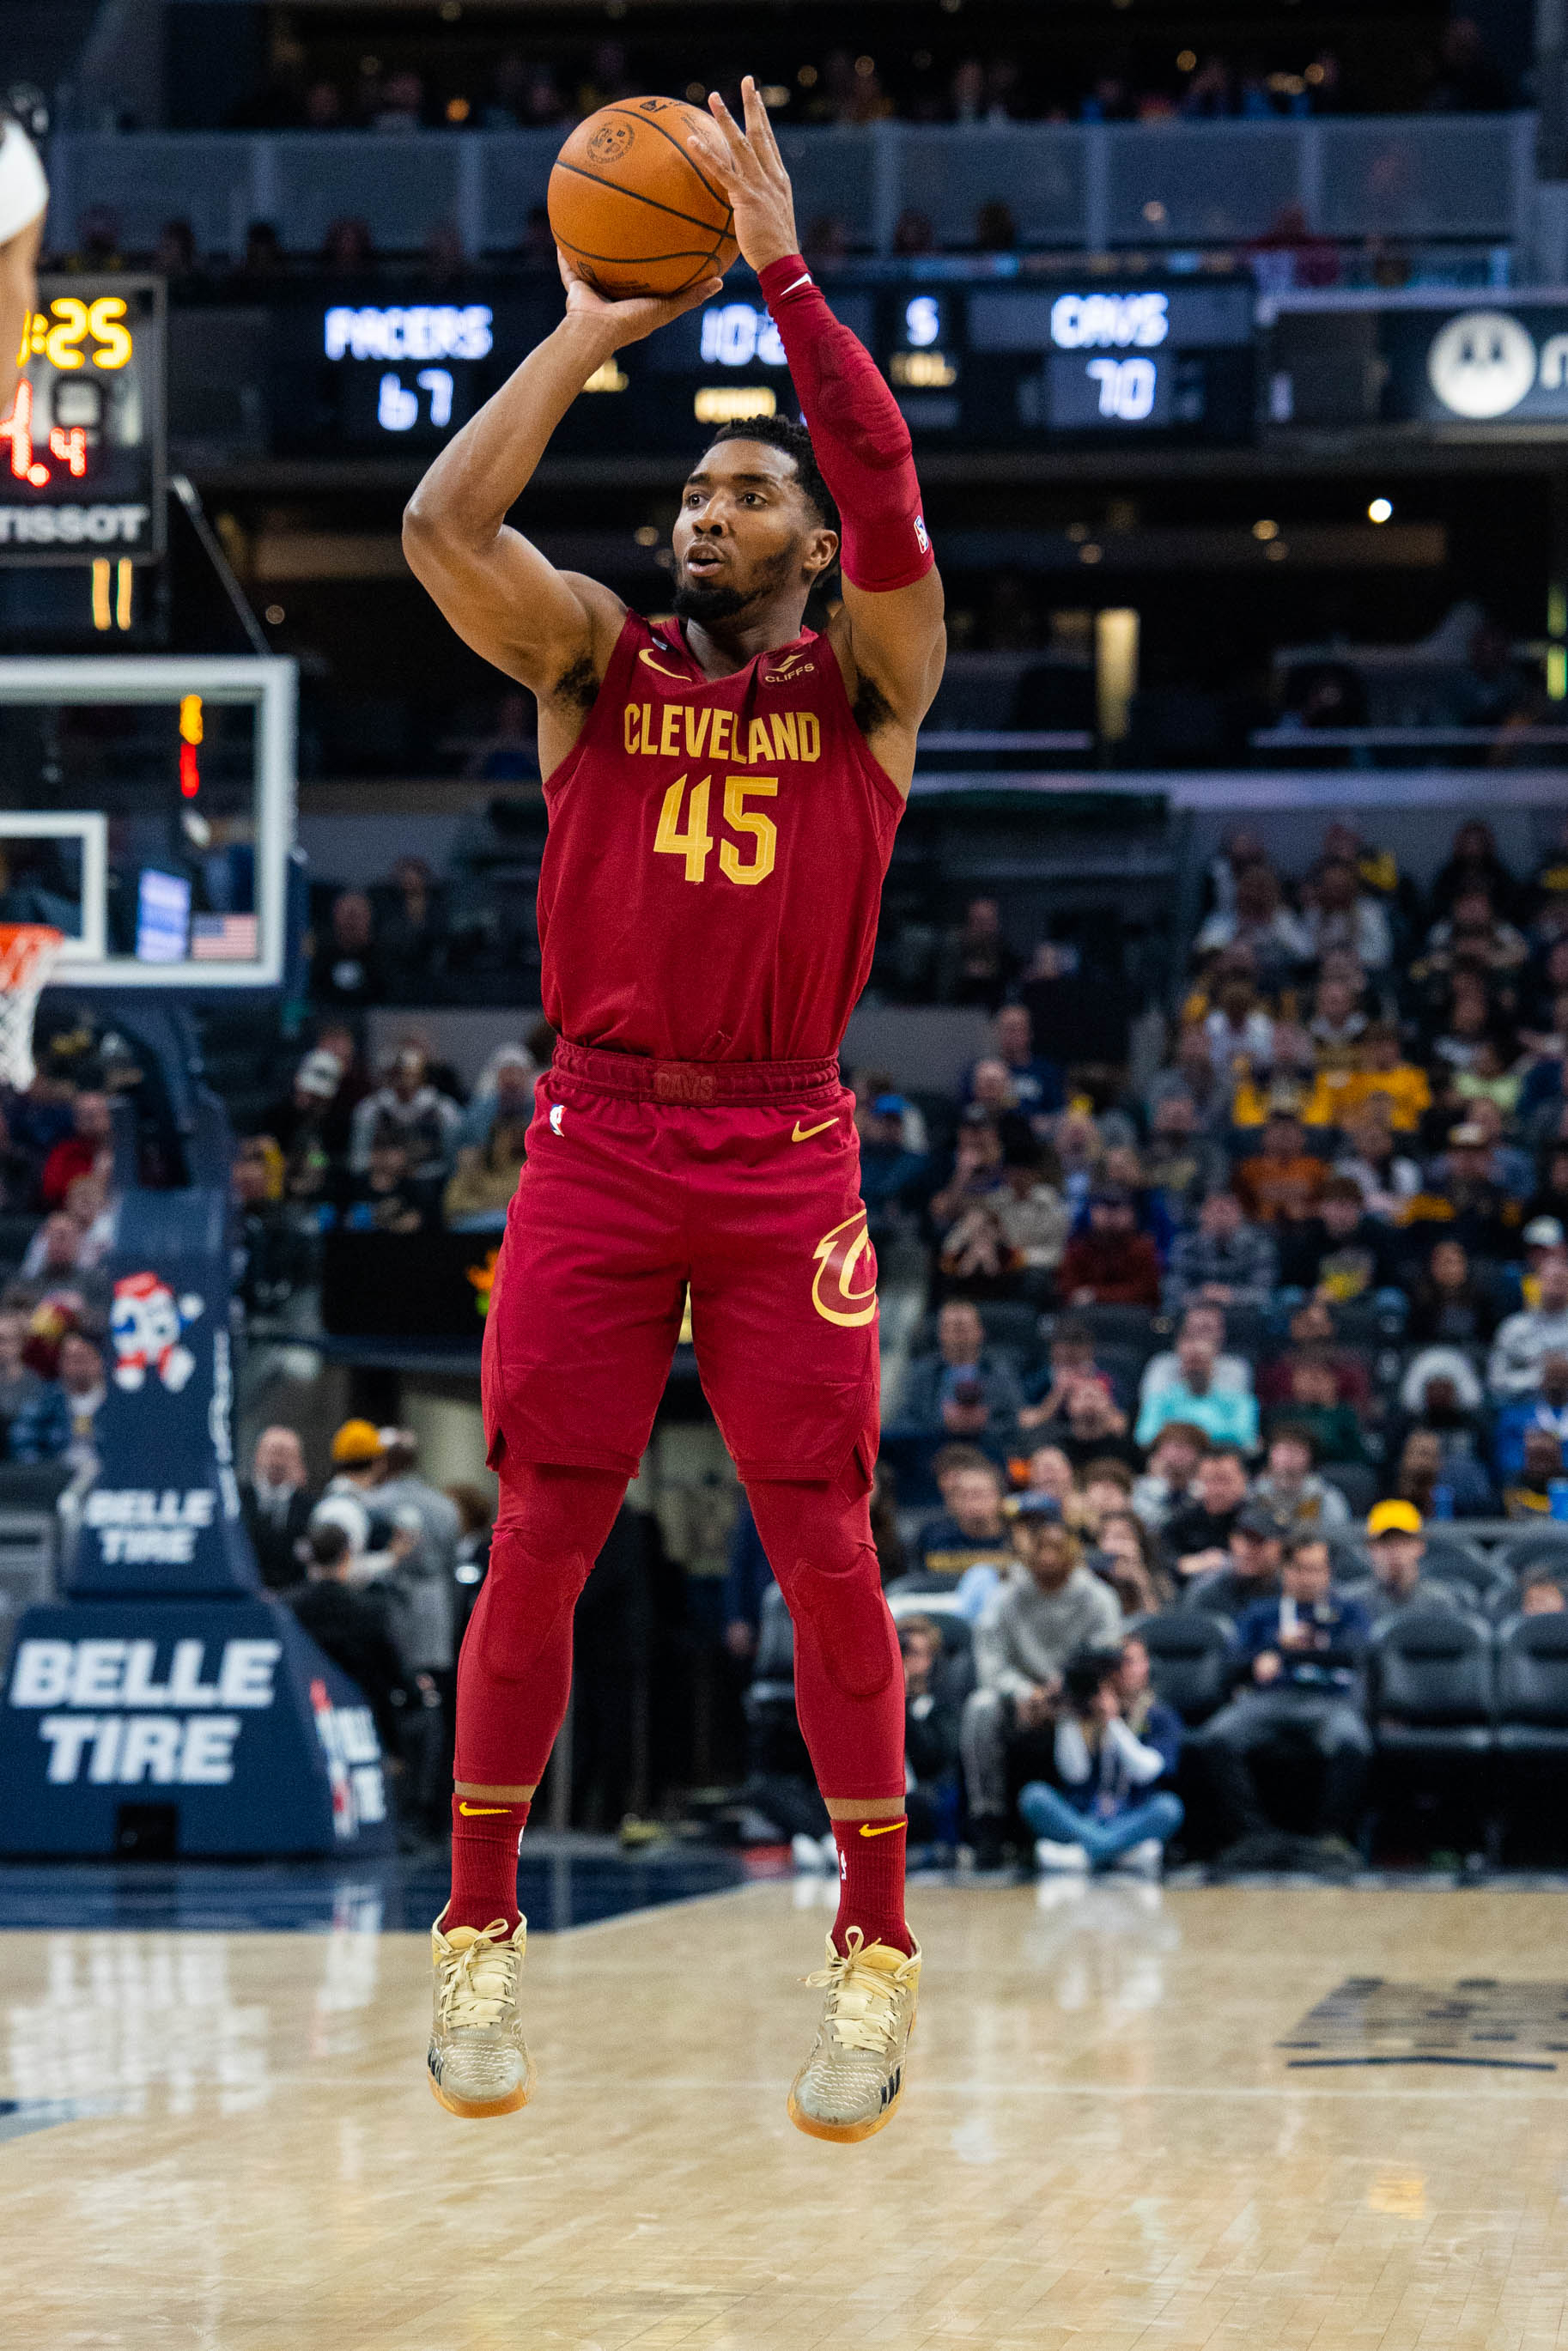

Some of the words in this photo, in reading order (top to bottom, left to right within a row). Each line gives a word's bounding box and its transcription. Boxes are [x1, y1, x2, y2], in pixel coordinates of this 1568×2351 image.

[325, 306, 493, 361] PACERS
[378, 368, 453, 431] 67
[1085, 357, 1157, 420] 70
[764, 663, 815, 683] CLIFFS
[624, 703, 821, 764] CLEVELAND
[653, 773, 779, 885] 45
[86, 1488, 214, 1527] BELLE
[100, 1528, 198, 1564] TIRE
[9, 1637, 282, 1709] BELLE
[40, 1714, 241, 1786] TIRE
